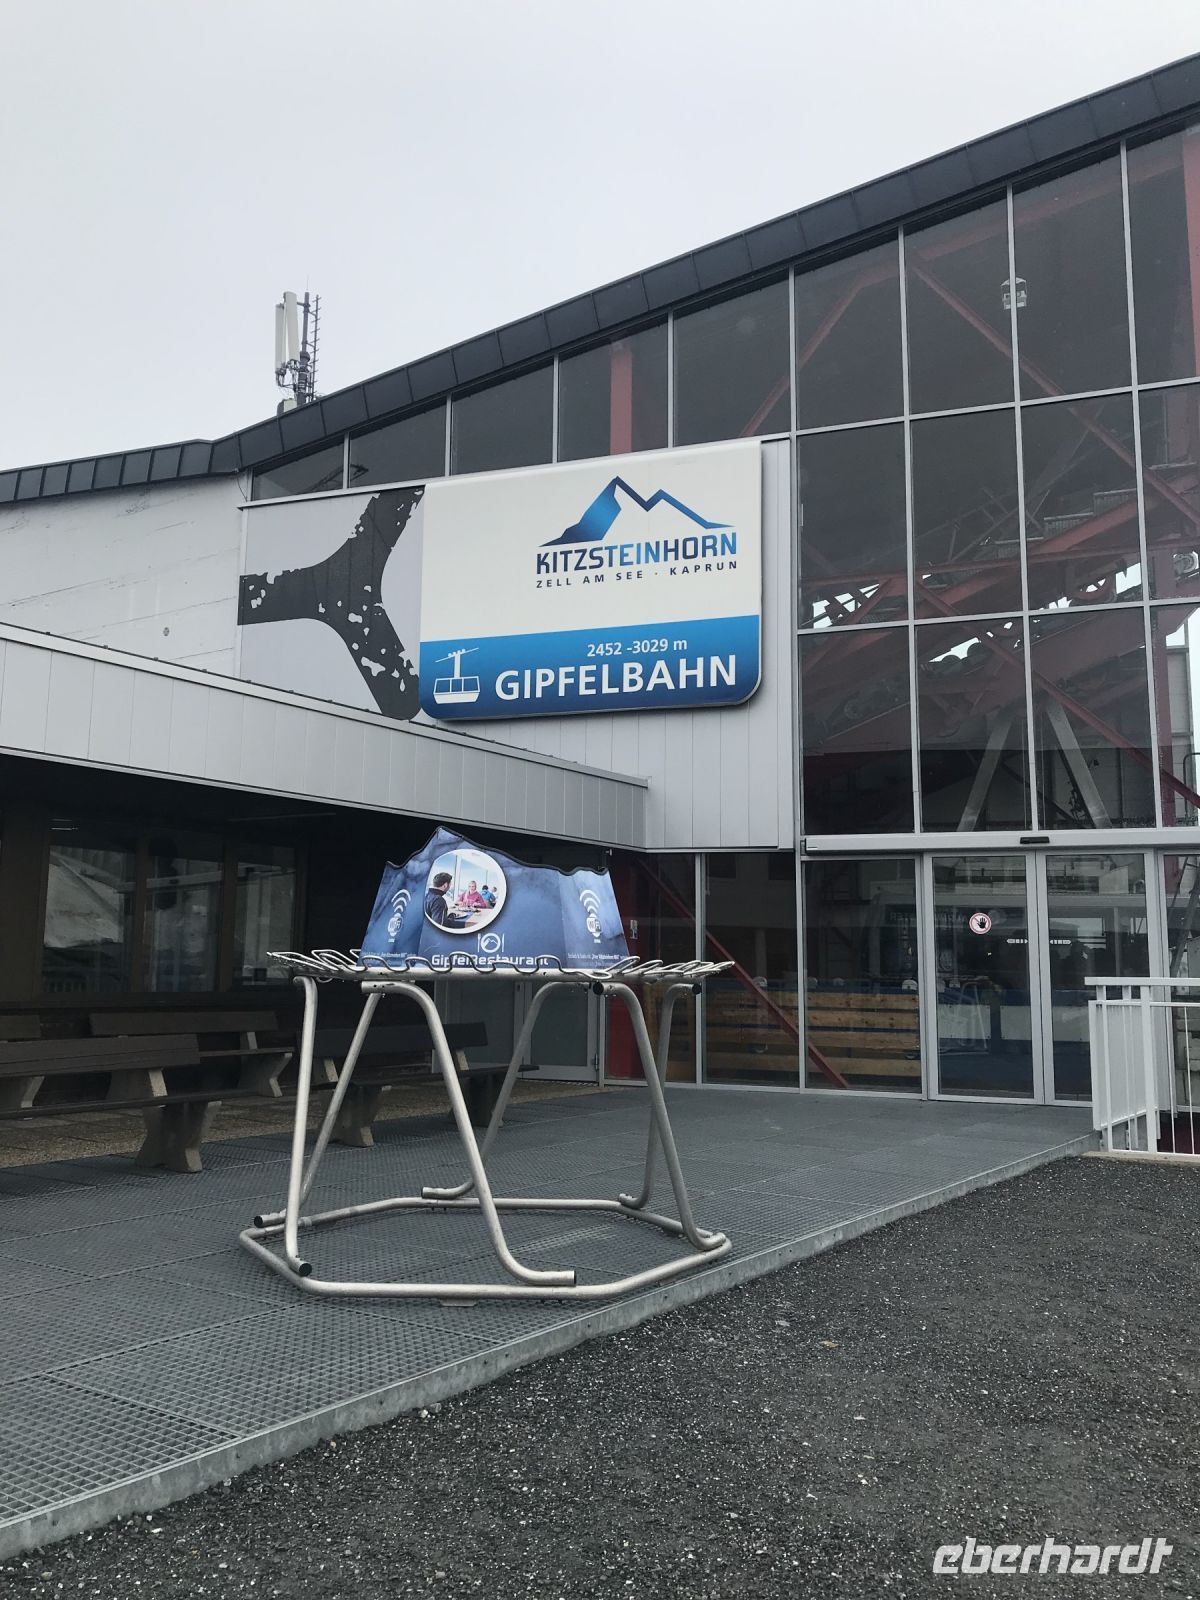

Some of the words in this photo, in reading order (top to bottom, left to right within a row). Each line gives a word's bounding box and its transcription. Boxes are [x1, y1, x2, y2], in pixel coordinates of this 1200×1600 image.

[536, 532, 737, 575] KITZSTEINHORN
[536, 577, 572, 589] ZELL
[582, 574, 605, 585] AM
[615, 569, 644, 581] SEE
[669, 560, 737, 576] KAPRUN
[587, 641, 623, 657] 2452
[627, 638, 669, 655] -3029
[673, 639, 688, 651] m
[495, 654, 737, 701] GIPFELBAHN
